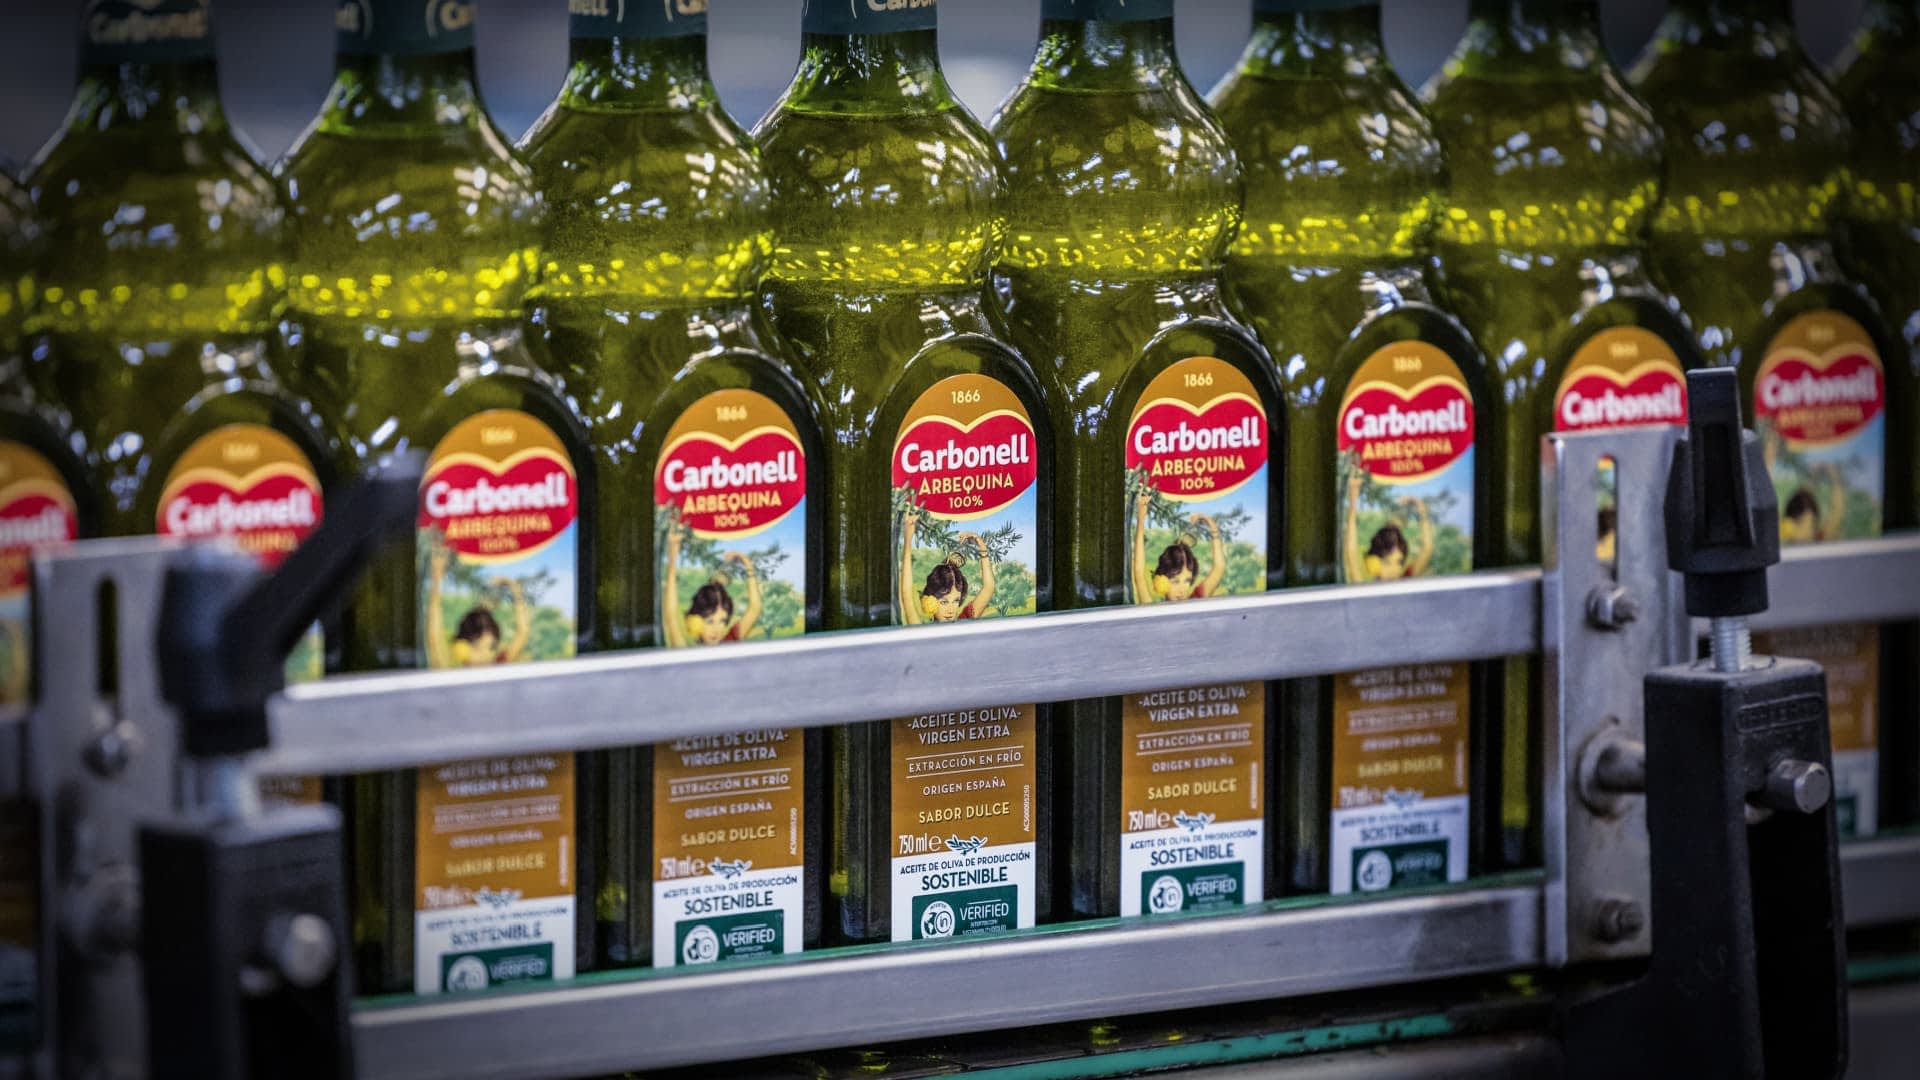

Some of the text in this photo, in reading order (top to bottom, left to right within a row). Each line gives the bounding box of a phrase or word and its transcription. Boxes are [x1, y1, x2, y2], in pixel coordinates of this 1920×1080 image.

[1394, 356, 1422, 371] 1866
[1184, 372, 1213, 387] 1866
[1762, 365, 1877, 409] Carbonell
[952, 389, 980, 404] 1866
[1562, 382, 1682, 426] Carbonell
[716, 405, 747, 421] 1866
[1345, 398, 1467, 439] Carbonell
[1134, 416, 1260, 455] Carbonell
[901, 433, 1029, 473] Carbonell
[1362, 437, 1453, 459] ARBEQUINA
[664, 450, 797, 493] Carbonell
[1151, 455, 1245, 476] ARBEQUINA
[426, 471, 569, 517] Carbonell
[919, 473, 1014, 495] ARBEQUINA
[1180, 477, 1215, 490] 100%
[166, 487, 316, 537] Carbonell
[683, 491, 781, 514] ARBEQUINA
[949, 496, 983, 508] 100%
[445, 513, 551, 539] ARBEQUINA
[714, 513, 750, 527] 100%
[1189, 690, 1205, 702] DE
[959, 710, 975, 725] DE
[1149, 703, 1239, 722] VIRGEN EXTRA
[724, 733, 740, 746] DE
[919, 724, 1010, 745] VIRGEN EXTRA
[1139, 728, 1250, 750] EXTRACCIÓN EN FRÍO
[681, 747, 777, 767] VIRGEN EXTRA
[909, 748, 1021, 773] EXTRACCIÓN EN FRÍO
[1152, 752, 1234, 772] ORIGEN ESPAÑA
[671, 772, 788, 796] EXTRACCIÓN EN FRÍO
[923, 776, 1006, 796] ORIGEN ESPAÑA
[1148, 779, 1237, 800] SABOR DULCE
[685, 800, 772, 820] ORIGEN ESPAÑA
[919, 801, 1010, 824] SABOR DULCE
[1129, 811, 1143, 831] 750
[1361, 820, 1440, 842] SOSTENIBLE
[681, 825, 776, 846] SABOR DULCE
[899, 834, 914, 855] 750
[1130, 839, 1154, 849] ACEITE
[1157, 838, 1166, 847] DE
[1169, 836, 1190, 846] OLIVA
[446, 853, 546, 877] SABOR DULCE
[900, 850, 1030, 875] ACEITE DE OLIVA DE PRODUCCIÓN
[1151, 843, 1235, 866] SOSTENIBLE
[663, 888, 689, 899] ACEITE
[729, 883, 738, 891] DE
[741, 876, 797, 891] PRODUCCIÓN
[922, 866, 1008, 891] SOSTENIBLE
[1187, 878, 1237, 897] VERIFIED
[684, 891, 773, 915] SOSTENIBLE
[959, 902, 1009, 921] VERIFIED
[452, 920, 543, 946] SOSTENIBLE
[722, 928, 775, 948] VERIFIED
[489, 957, 547, 979] VERIFIED
